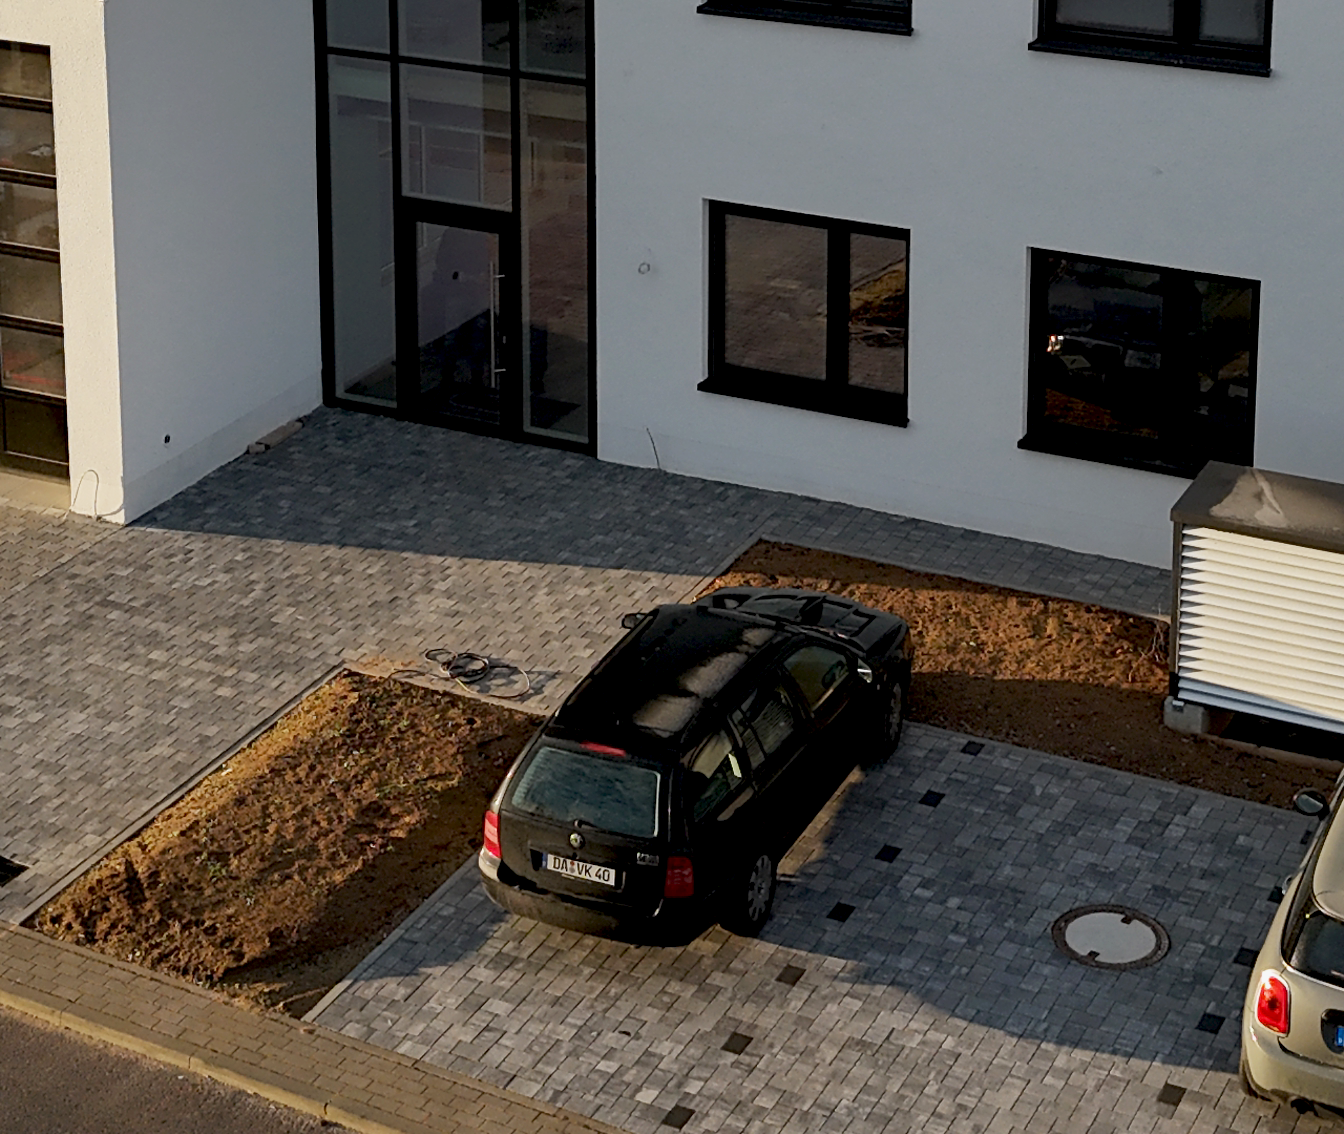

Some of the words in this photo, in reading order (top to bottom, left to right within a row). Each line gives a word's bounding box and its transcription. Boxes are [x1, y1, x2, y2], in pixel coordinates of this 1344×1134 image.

[553, 856, 568, 872] DA
[576, 862, 592, 878] VK
[595, 868, 611, 882] 40
